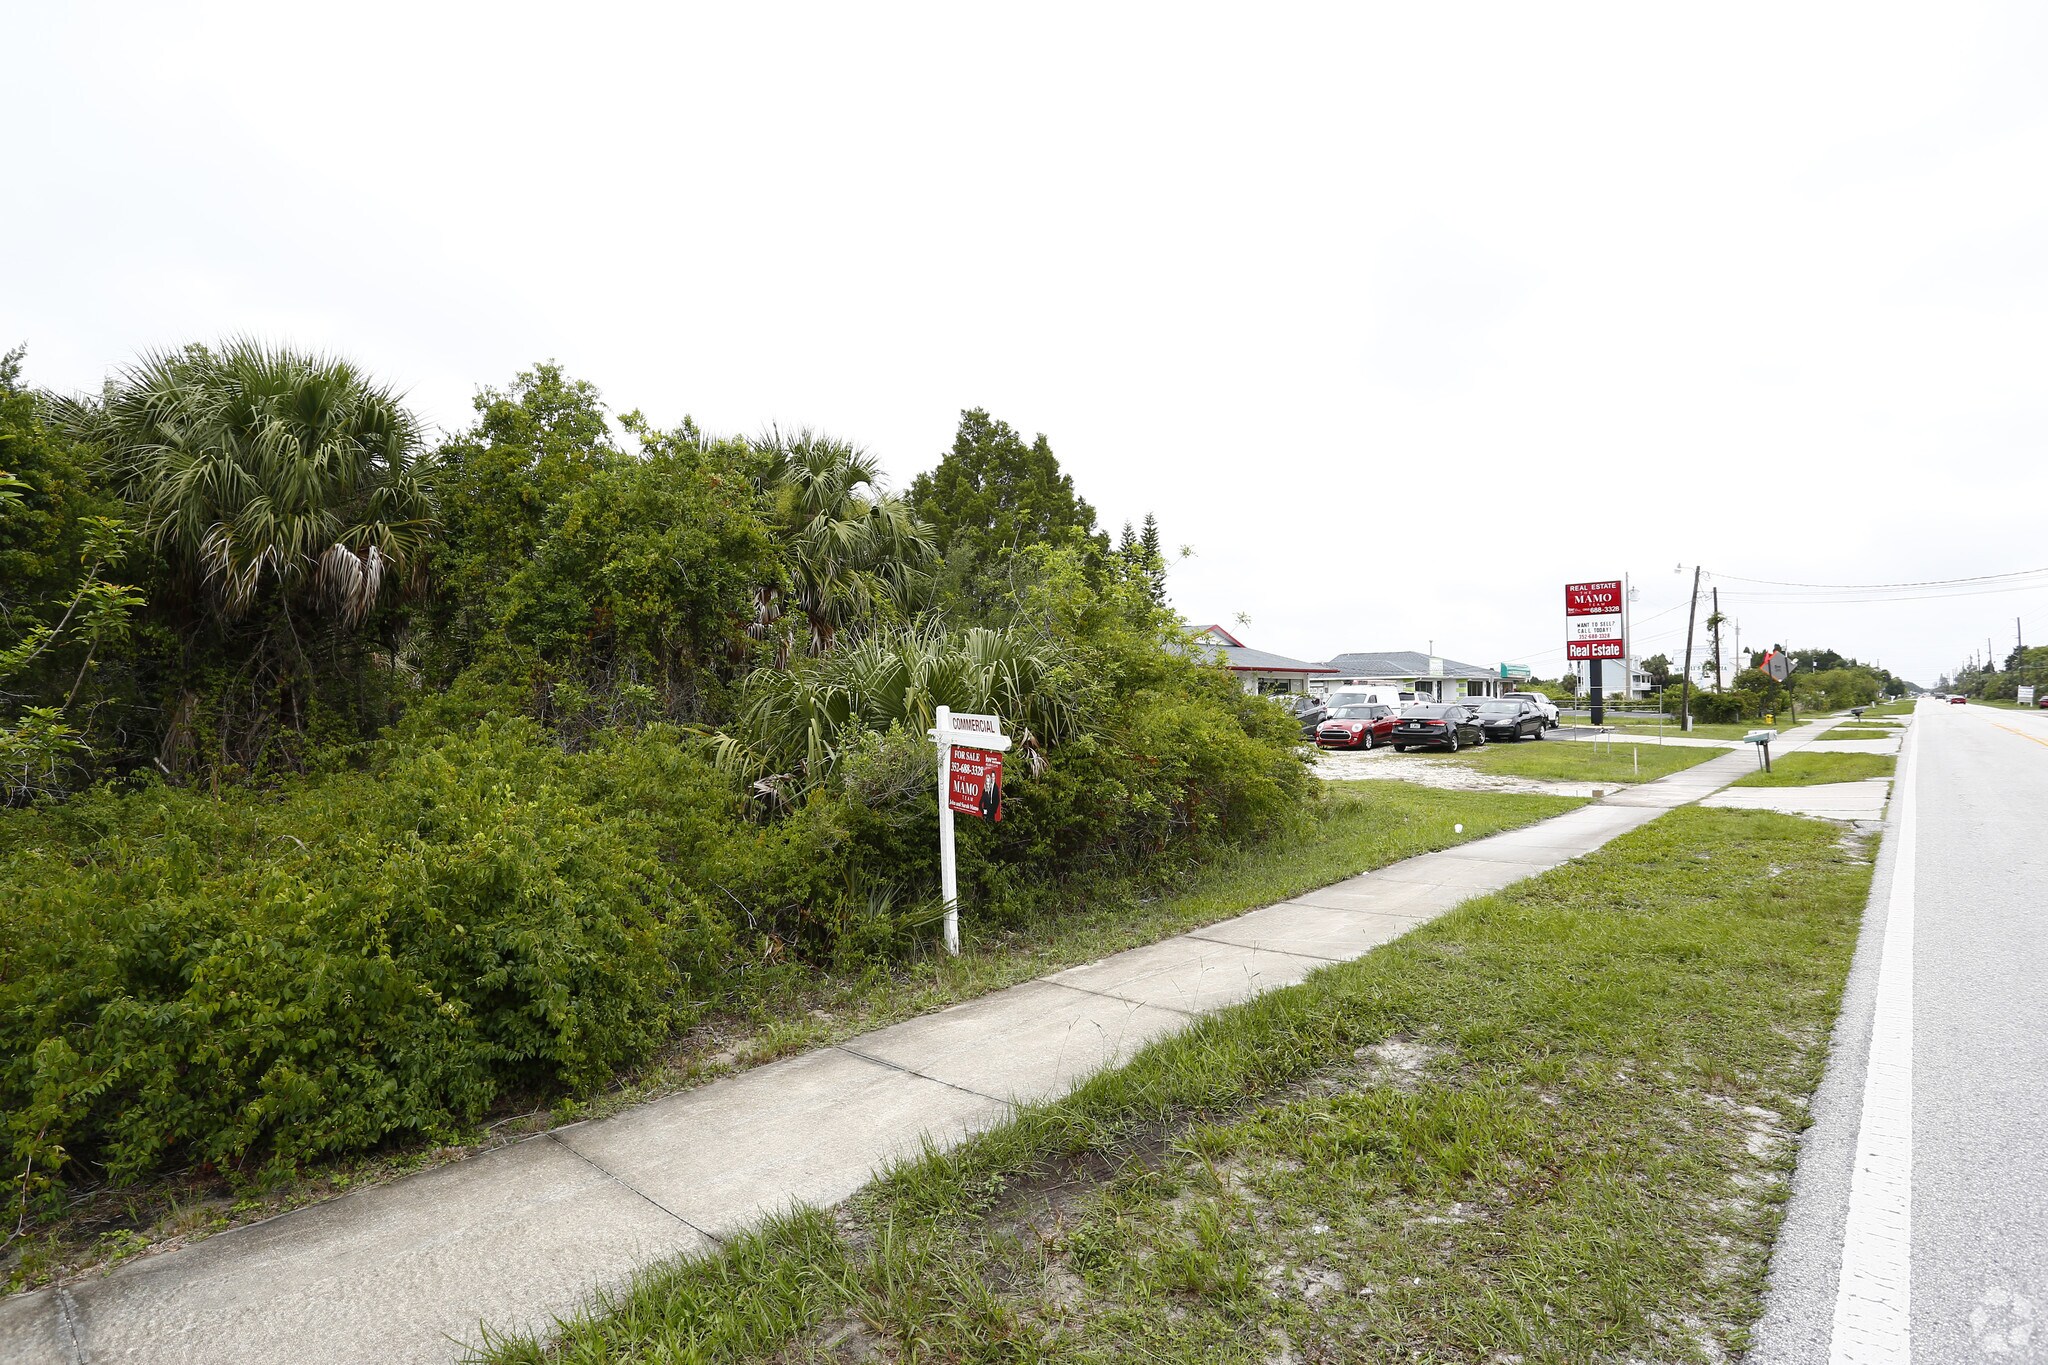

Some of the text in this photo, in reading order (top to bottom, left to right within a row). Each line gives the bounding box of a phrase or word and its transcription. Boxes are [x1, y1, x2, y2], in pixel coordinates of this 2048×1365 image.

[1574, 593, 1612, 604] MAMO
[1569, 643, 1620, 657] Real Estate
[952, 717, 995, 733] COMMERCIAL
[954, 750, 966, 760] FOR
[966, 752, 980, 762] SALE
[951, 761, 984, 777] 352-688-3328
[953, 780, 979, 796] MAMO
